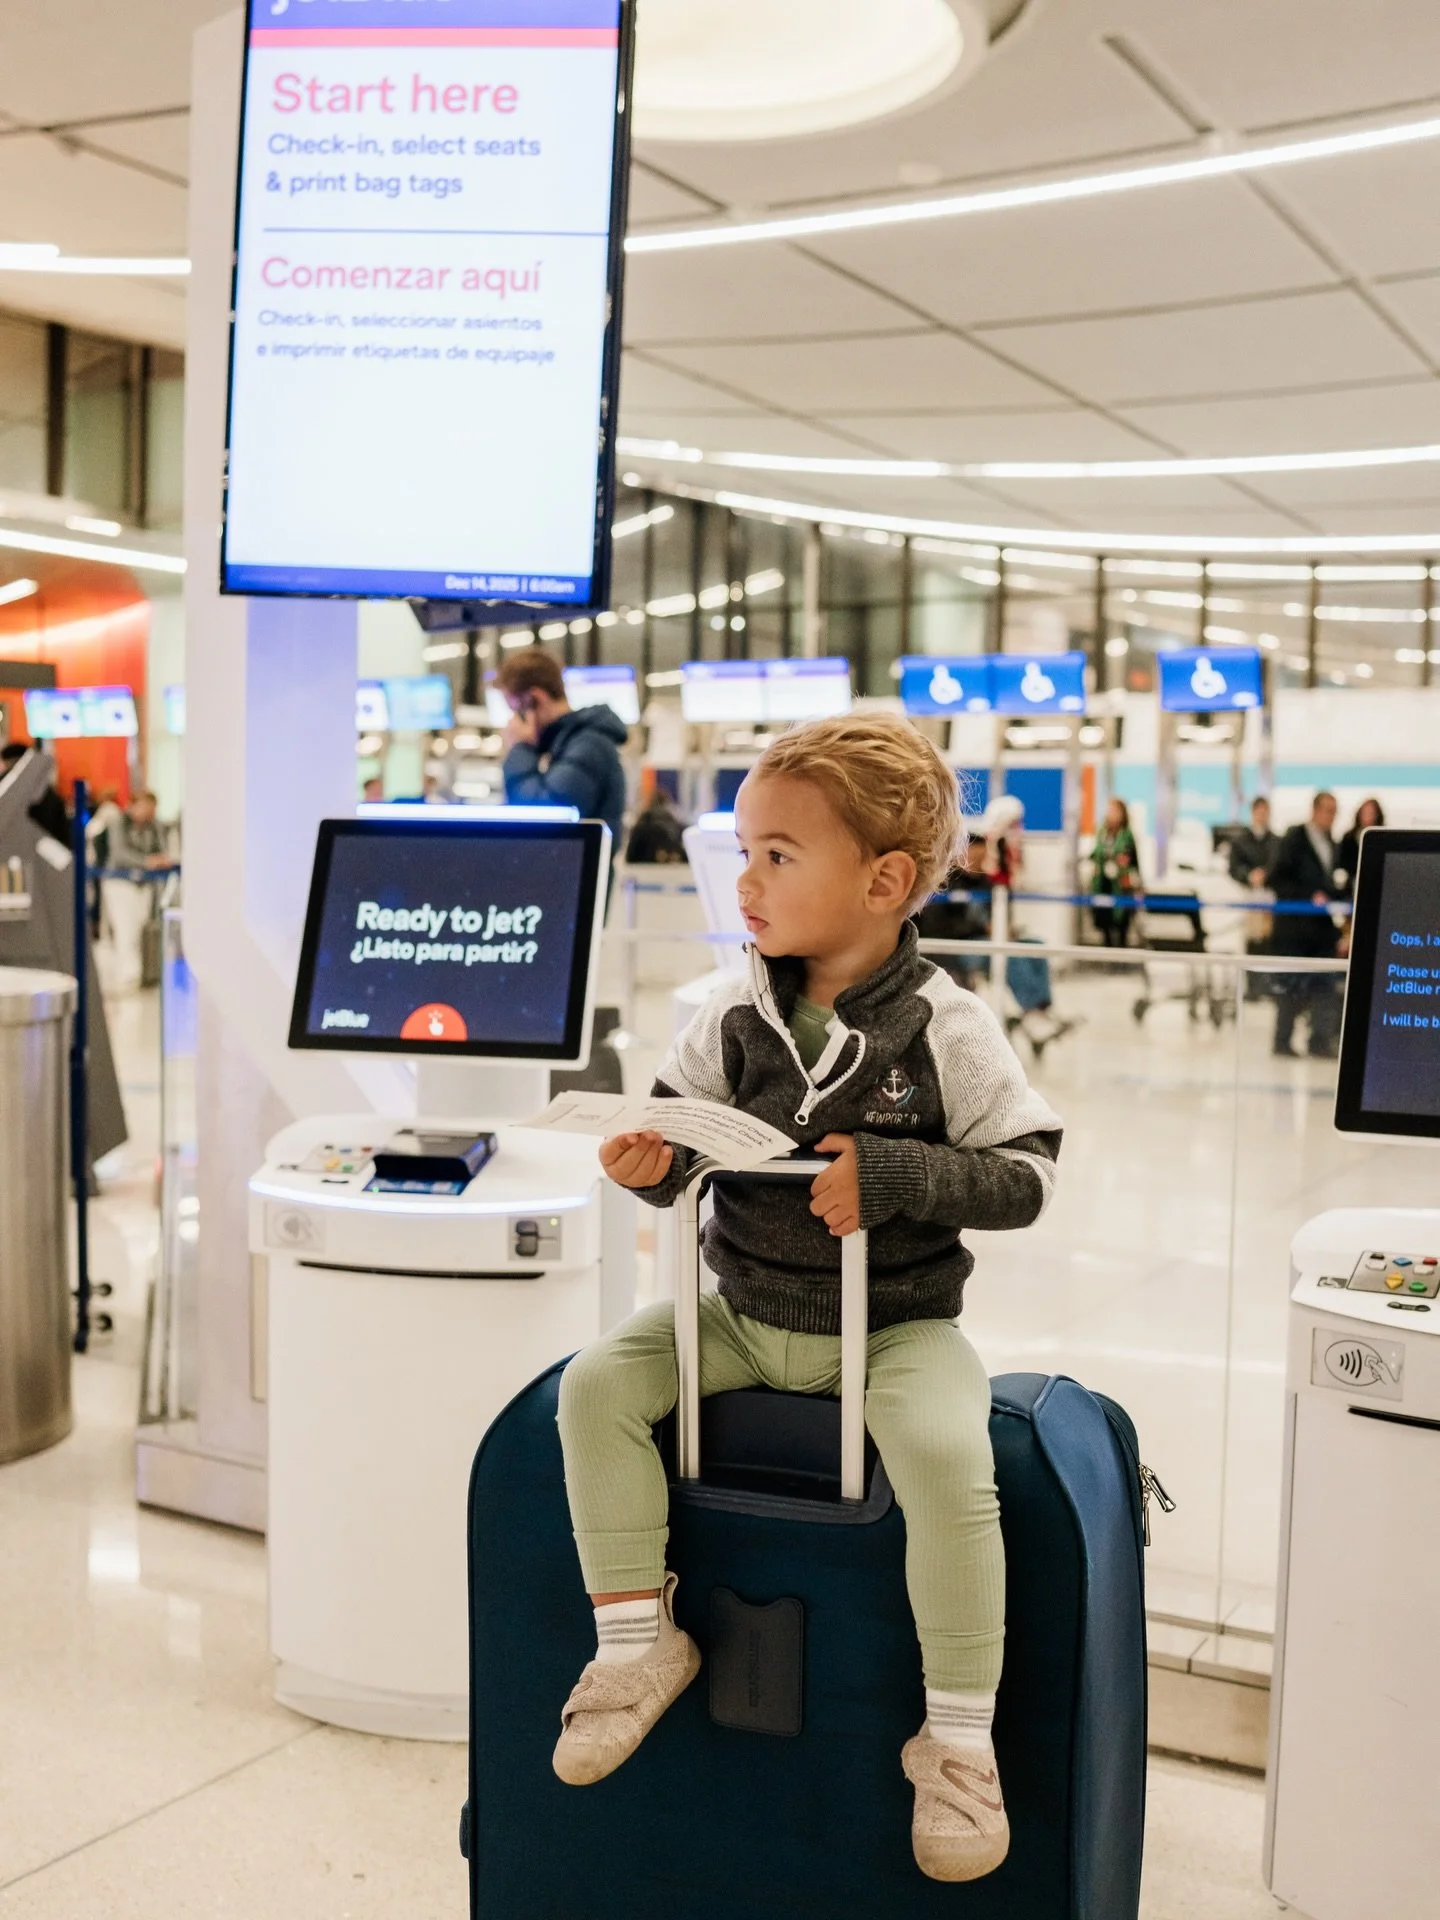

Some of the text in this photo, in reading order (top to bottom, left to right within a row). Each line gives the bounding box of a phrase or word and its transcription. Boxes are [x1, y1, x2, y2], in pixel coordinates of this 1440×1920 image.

[273, 73, 519, 114] Start here
[267, 132, 541, 157] Check-in, select seats
[266, 171, 463, 199] & print bag tags
[261, 257, 543, 299] Comenzar aquí
[257, 309, 543, 332] Check-in, seleccionar asientos
[256, 343, 556, 366] e imprimir etiquetas de equipaje
[356, 901, 542, 940] Ready to jet?
[1390, 931, 1424, 947] Oops,
[1427, 932, 1431, 946] I
[350, 936, 538, 967] ¿Listo para partir?
[1387, 963, 1429, 978] Please
[1385, 981, 1432, 995] JetBlue
[1383, 1012, 1440, 1028] I will be b
